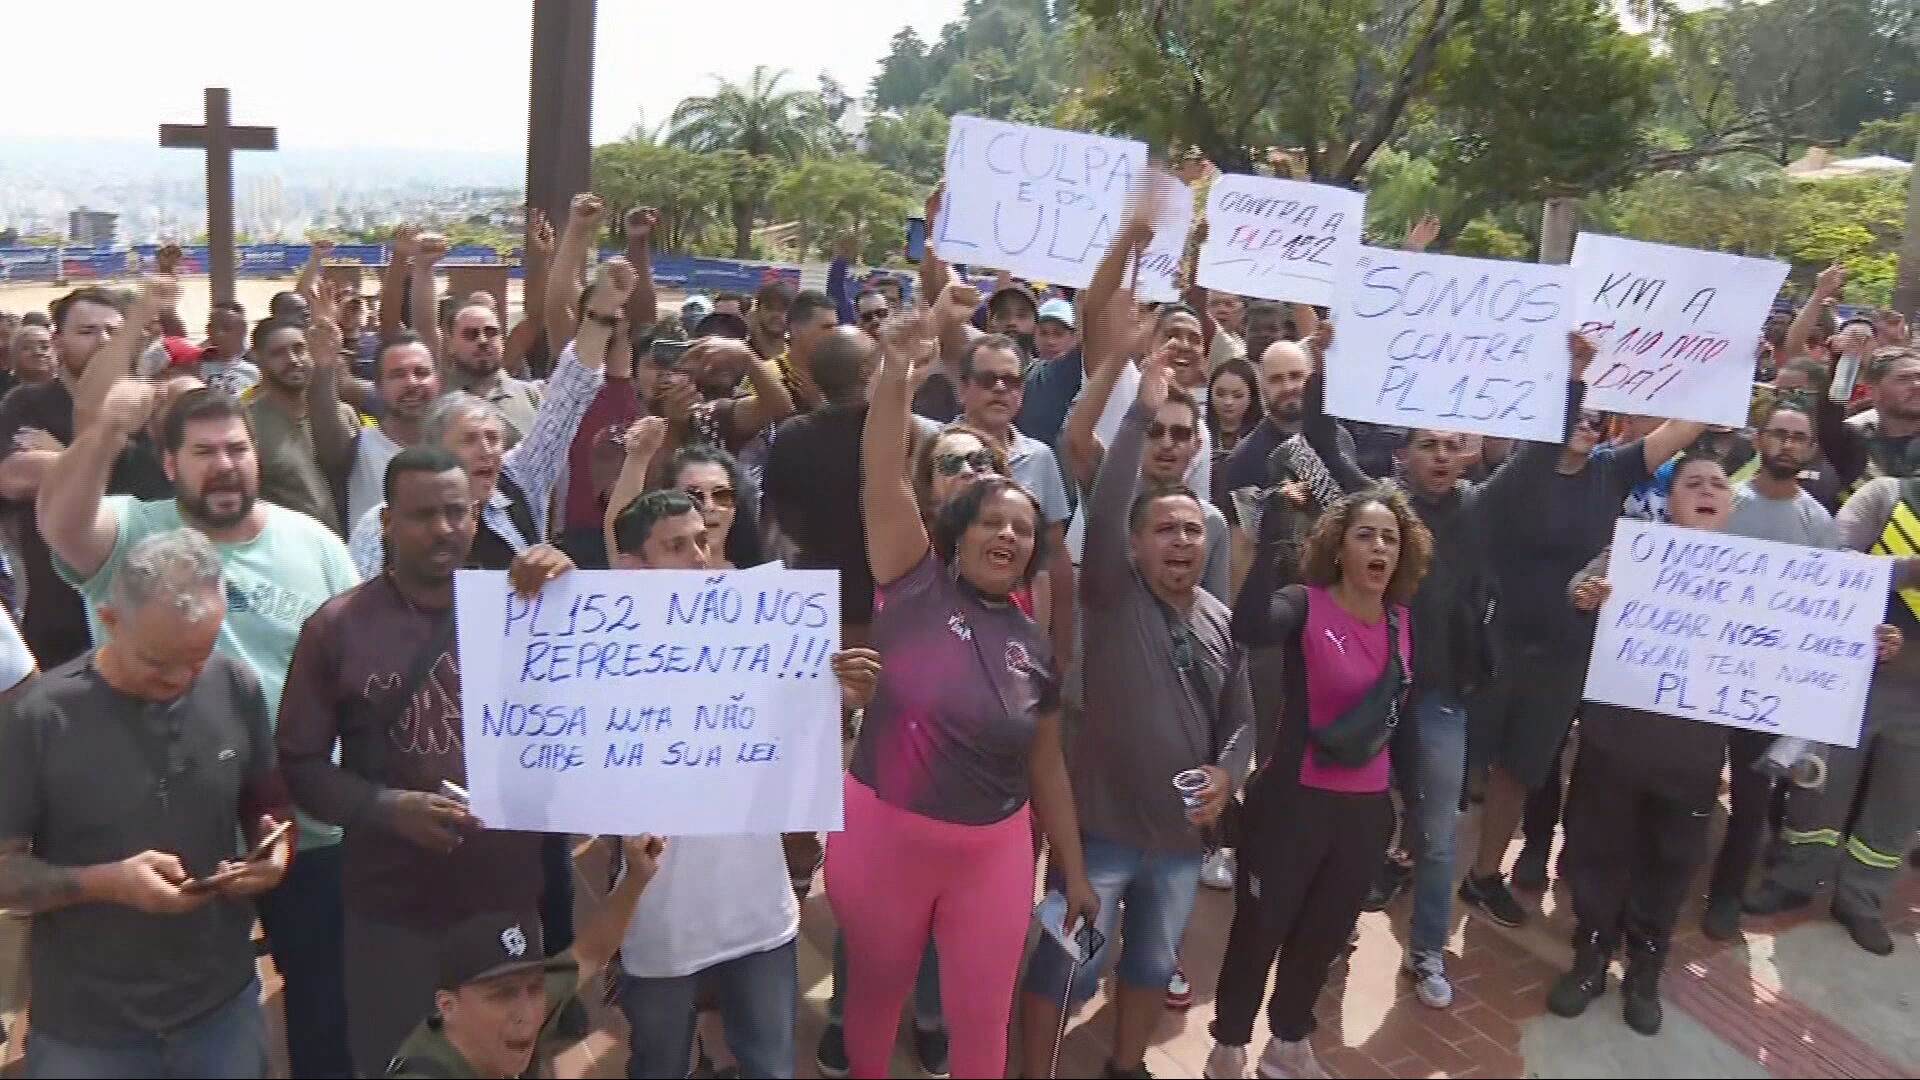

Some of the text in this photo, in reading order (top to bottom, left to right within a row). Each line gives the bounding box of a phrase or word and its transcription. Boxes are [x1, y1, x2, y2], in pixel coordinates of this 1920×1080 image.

[986, 130, 1132, 191] CULPA
[941, 192, 1114, 262] LULA
[1218, 191, 1345, 233] CONTRA A
[1593, 272, 1716, 325] KM A
[1387, 329, 1535, 364] CONTRA
[1376, 365, 1425, 411] PL
[1631, 532, 1655, 562] O
[1661, 538, 1768, 576] MOTOCA
[1778, 551, 1829, 587] NÃO
[504, 574, 829, 637] PL 152 NÃO NOS
[1652, 566, 1732, 604] PAGAR
[1739, 584, 1755, 605] A
[1615, 600, 1712, 638] ROUBAR
[1616, 637, 1689, 671] AGORA
[1704, 655, 1757, 680] TEM
[482, 691, 757, 737] NOSSA LUTA NÃO
[1655, 672, 1782, 726] PL 152
[519, 743, 585, 772] CABE
[604, 742, 643, 769] NA
[661, 740, 722, 768] SUA
